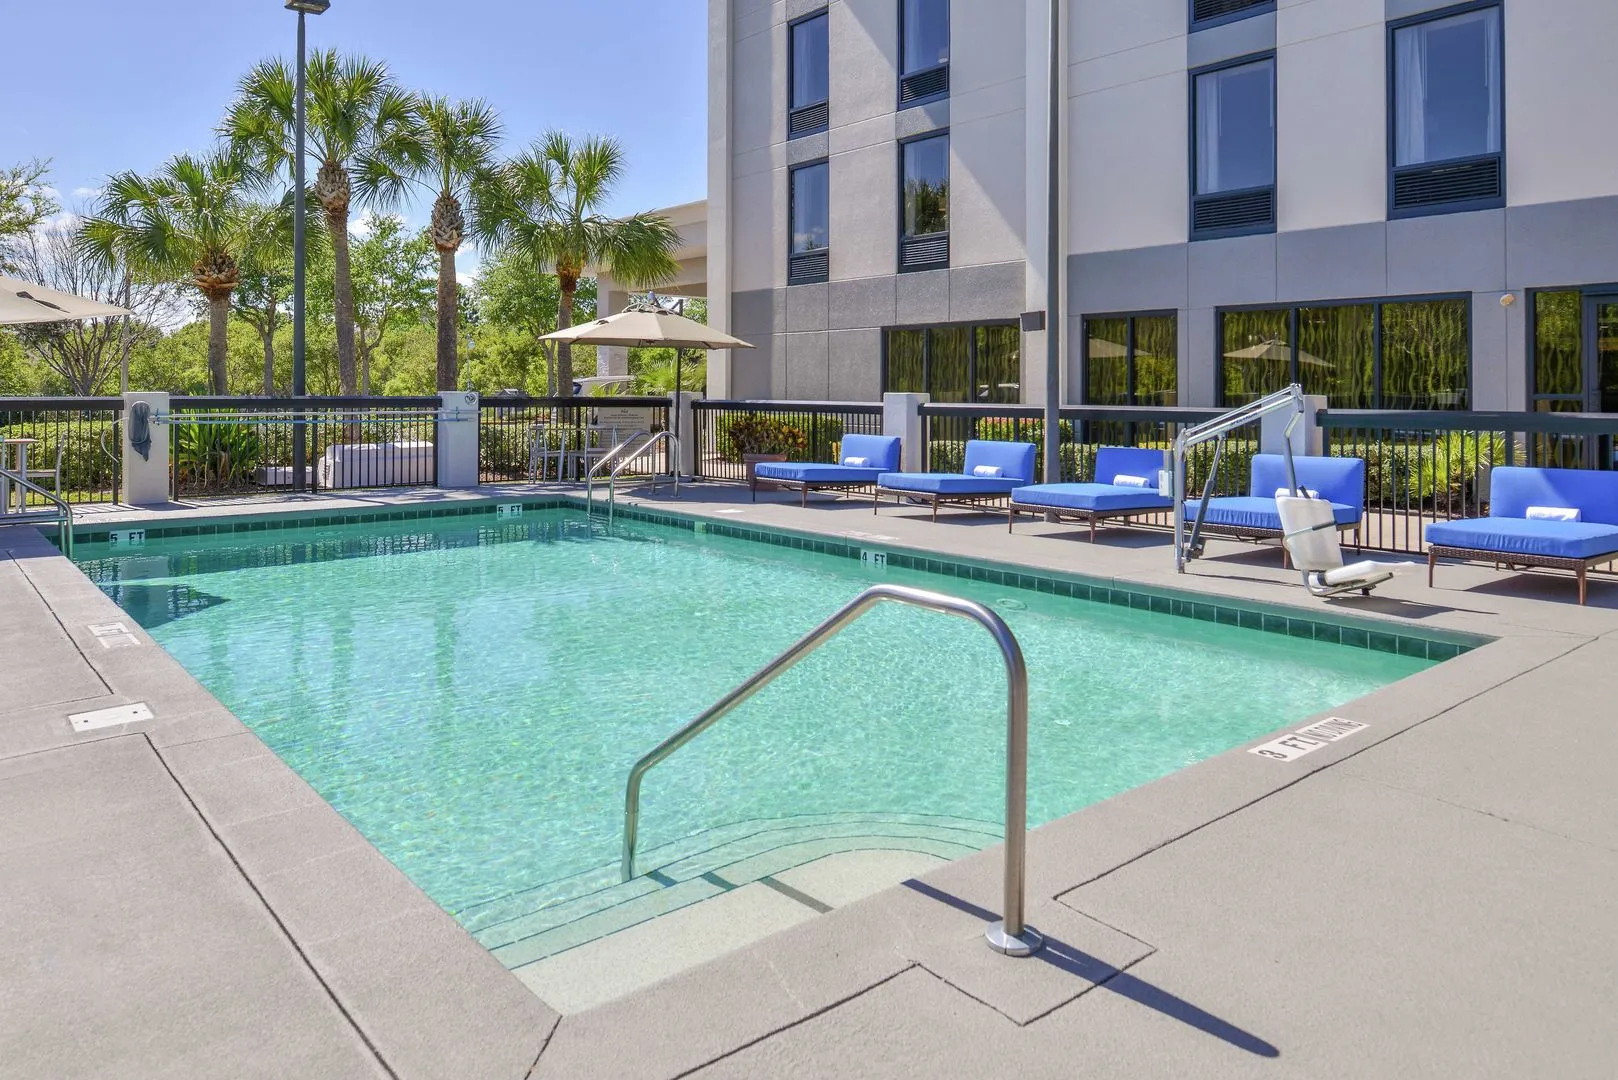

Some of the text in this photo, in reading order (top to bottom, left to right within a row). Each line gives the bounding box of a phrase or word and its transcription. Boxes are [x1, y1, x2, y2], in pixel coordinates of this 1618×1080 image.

[129, 531, 144, 541] FT
[861, 551, 886, 563] 4 FT
[1258, 736, 1320, 759] 3 FT
